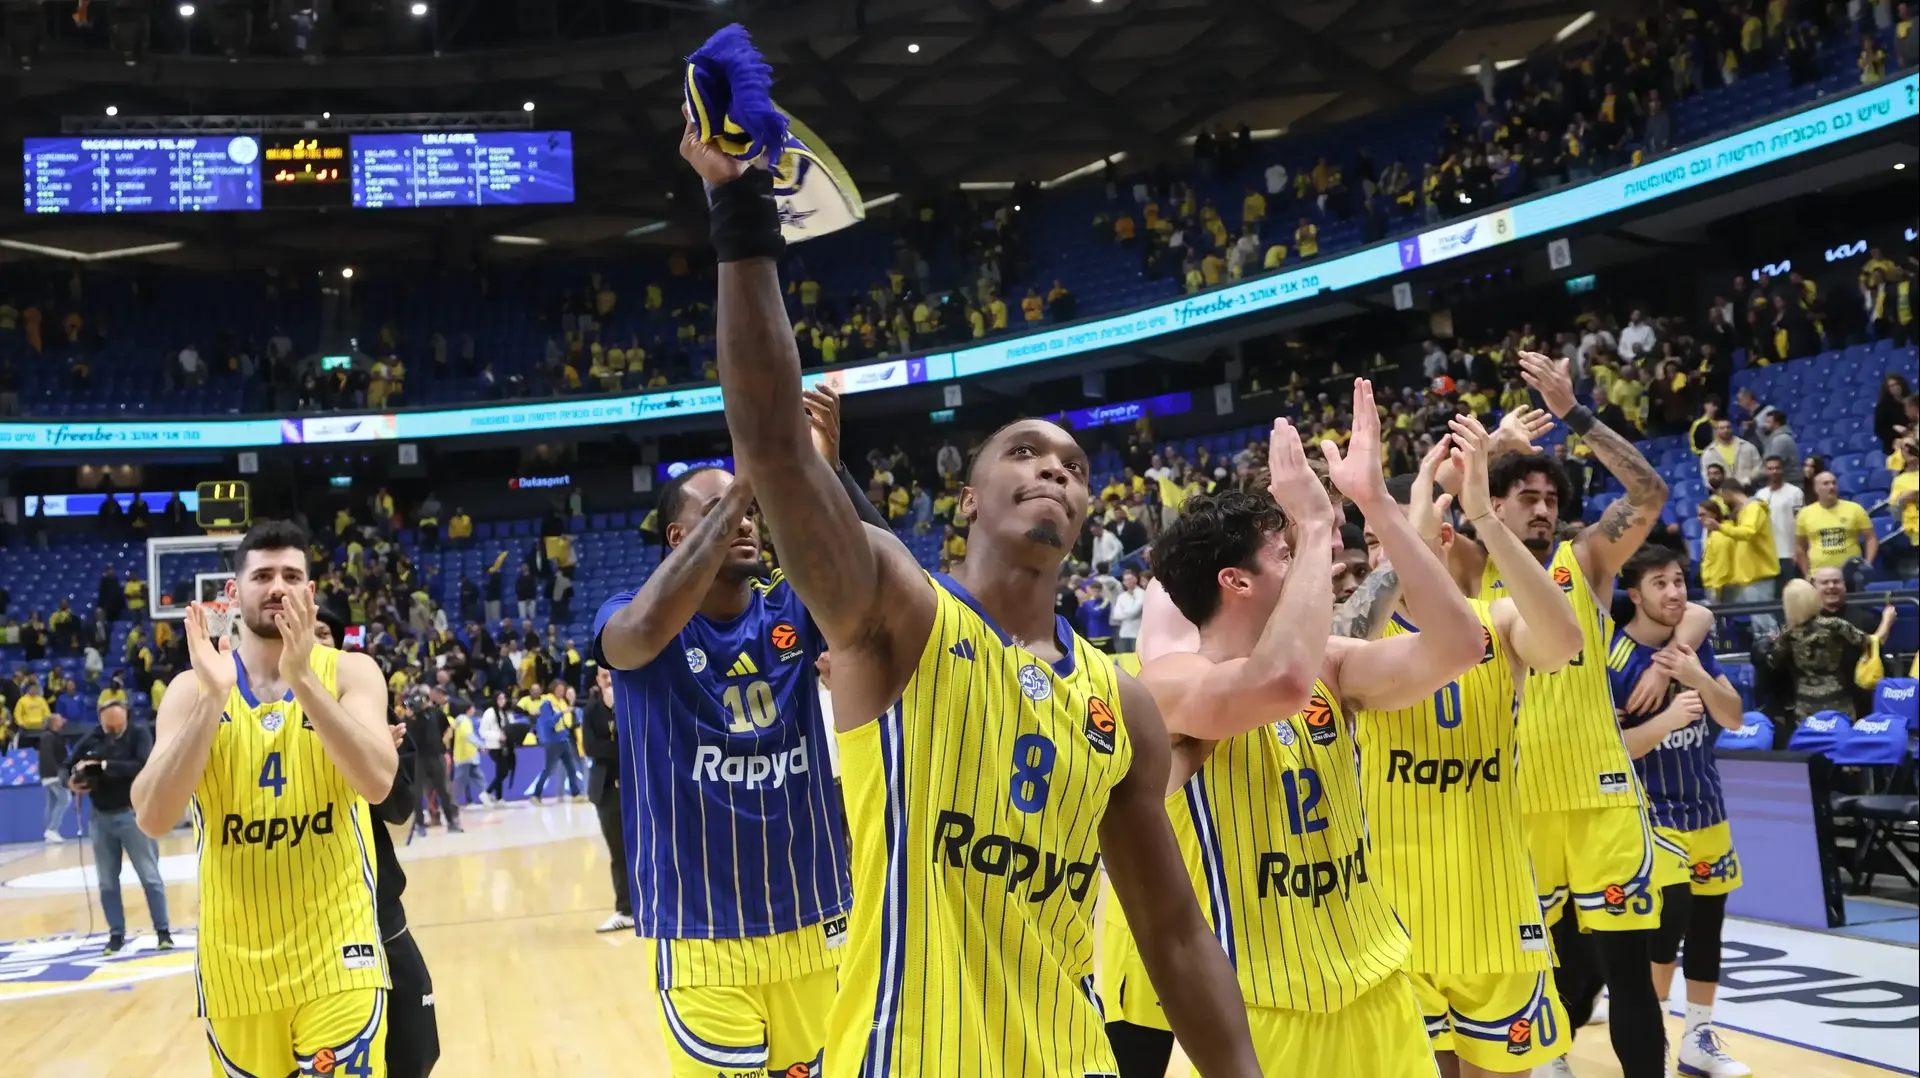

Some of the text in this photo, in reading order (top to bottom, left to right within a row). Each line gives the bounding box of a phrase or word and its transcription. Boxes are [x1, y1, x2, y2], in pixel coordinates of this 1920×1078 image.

[1404, 244, 1414, 263] 7
[912, 363, 921, 378] 7
[723, 680, 777, 733] 10
[1434, 681, 1462, 729] 0
[1882, 686, 1915, 701] Rapyd
[1804, 716, 1838, 732] Rapyd
[1853, 718, 1892, 734] Rapyd
[258, 752, 287, 798] 4
[692, 736, 809, 790] Rapyd
[1010, 733, 1056, 813] 8
[1387, 748, 1500, 793] Rapyd
[1281, 767, 1329, 835] 12
[222, 802, 333, 850] Rapyd
[932, 809, 1102, 903] Rapyd
[1258, 838, 1368, 908] Rapyd
[1538, 997, 1557, 1047] 0
[345, 1038, 373, 1078] 4
